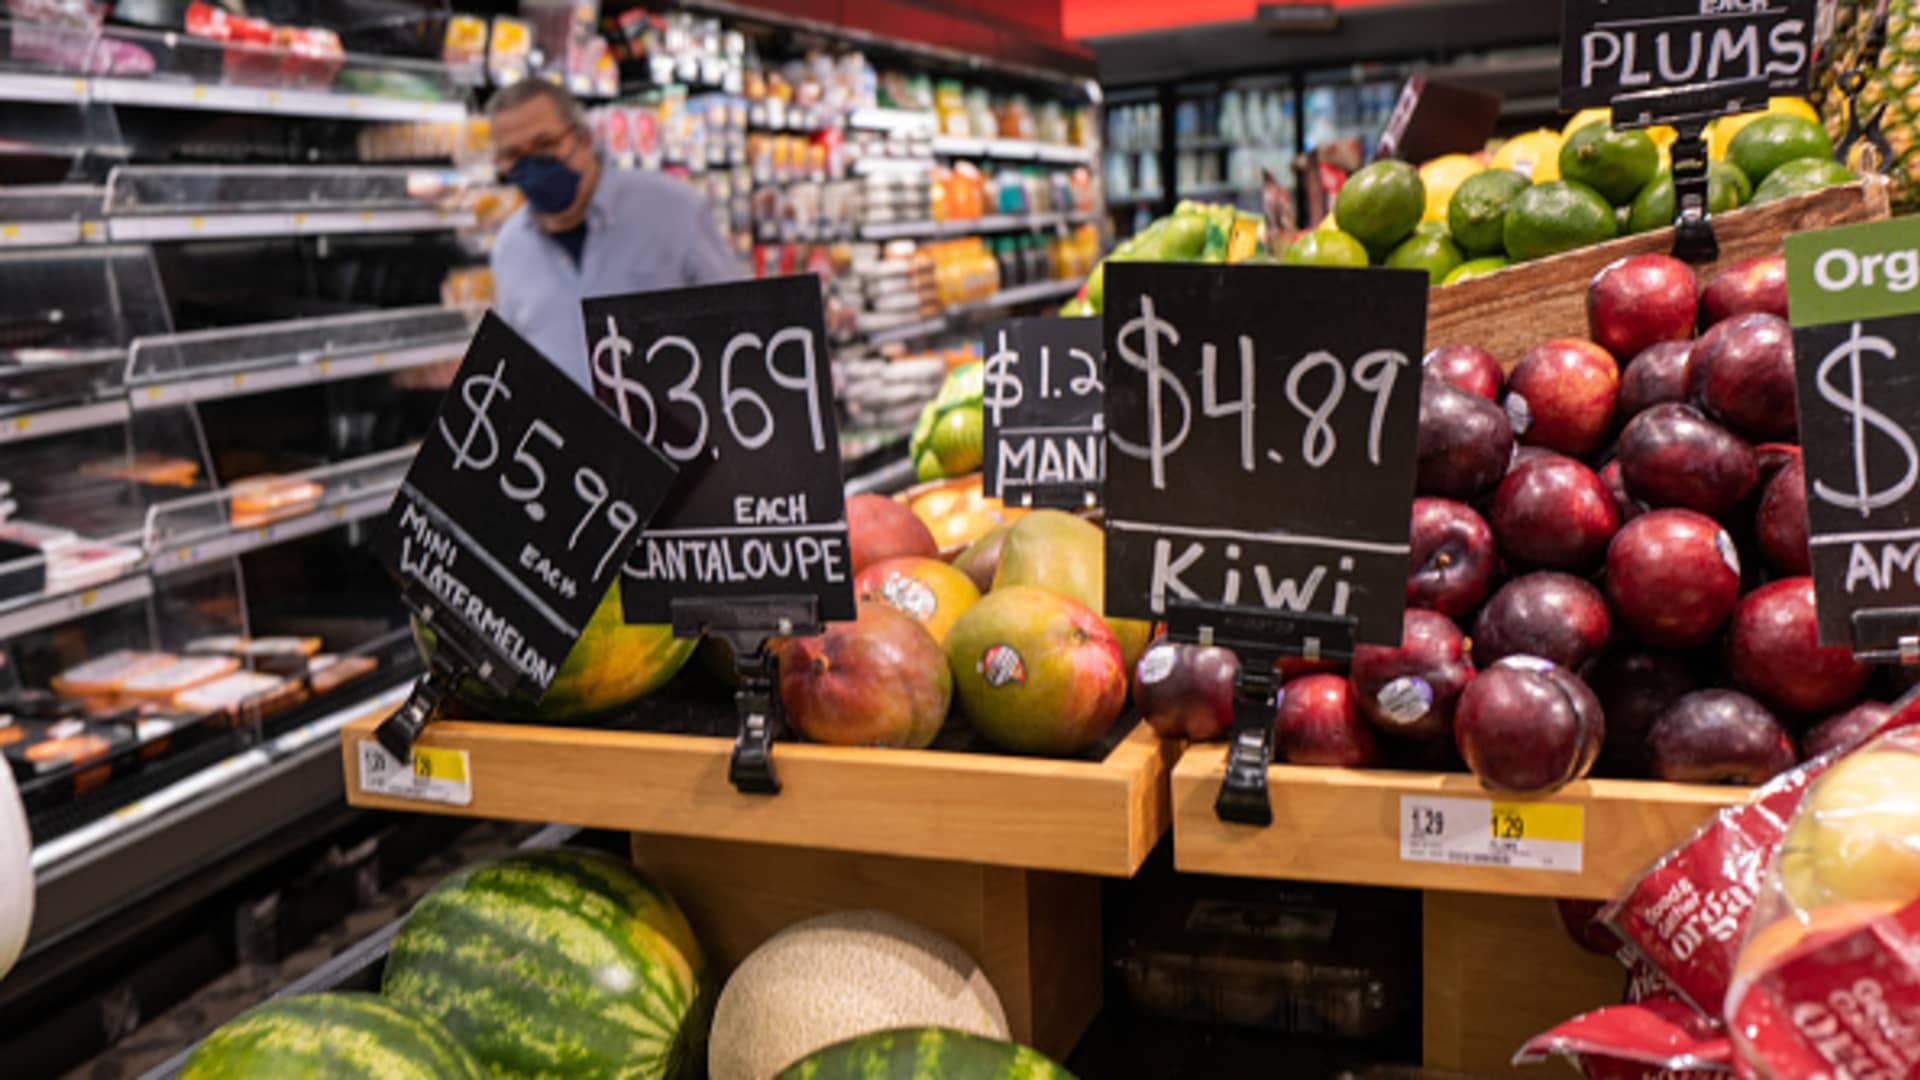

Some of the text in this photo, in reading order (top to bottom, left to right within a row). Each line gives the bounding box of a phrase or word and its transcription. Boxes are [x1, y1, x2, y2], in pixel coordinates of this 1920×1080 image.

[1581, 20, 1807, 88] PLUMS
[592, 315, 826, 462] $3.69
[983, 331, 1105, 426] $1.2
[1109, 294, 1409, 489] $4.89
[439, 358, 638, 583] $5.99
[998, 436, 1107, 488] MAN
[399, 503, 457, 567] MINI
[734, 494, 806, 525] EACH
[519, 543, 577, 599] EACH
[1151, 538, 1356, 614] Kiwi
[401, 537, 557, 689] WATERMELON
